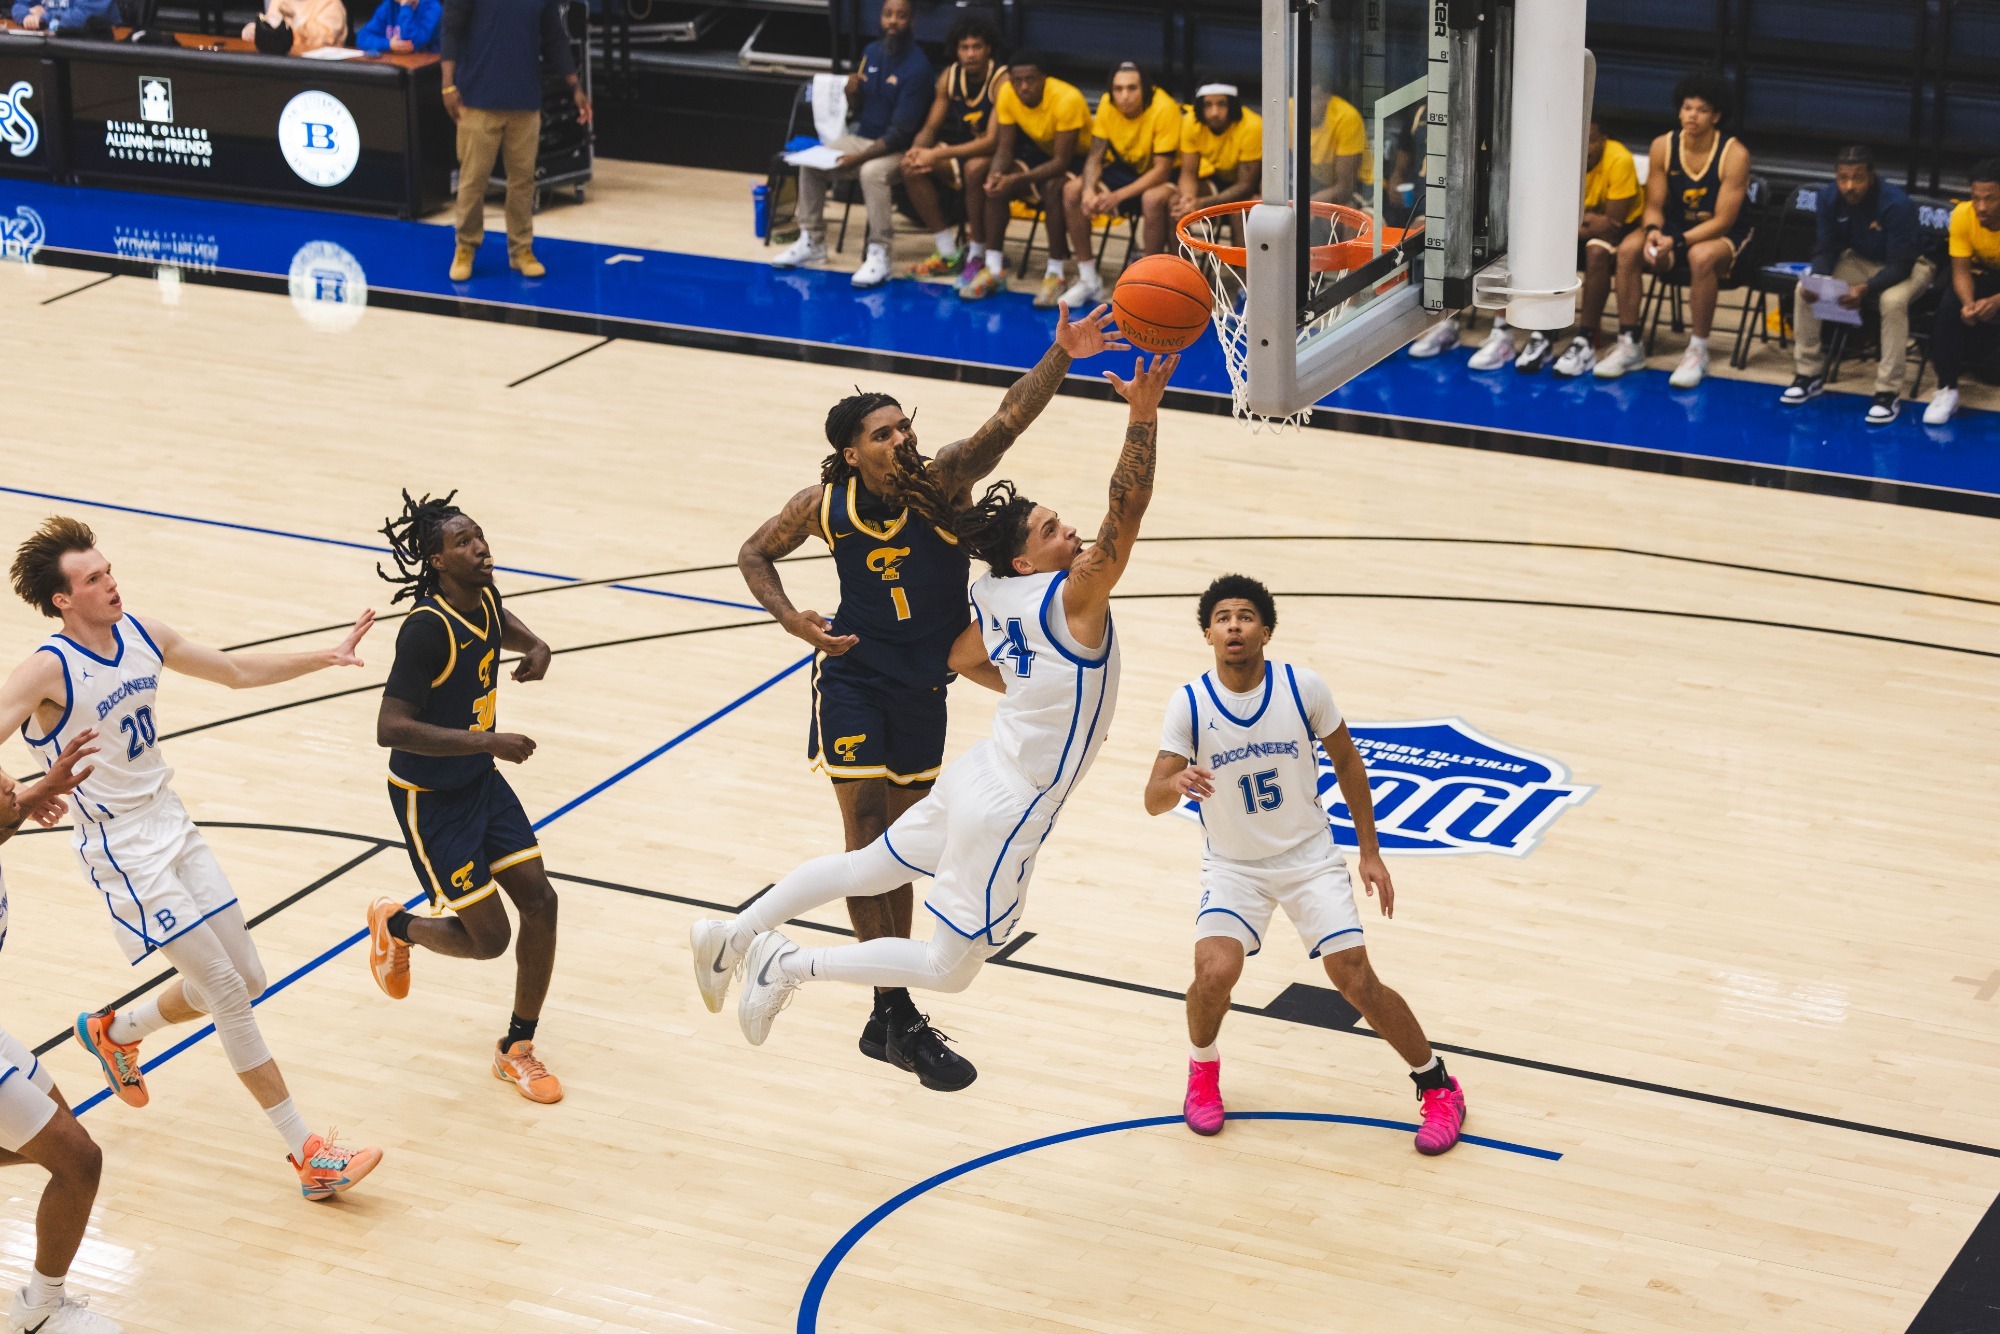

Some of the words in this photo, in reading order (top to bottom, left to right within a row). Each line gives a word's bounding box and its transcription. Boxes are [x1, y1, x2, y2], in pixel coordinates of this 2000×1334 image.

[1429, 113, 1448, 122] 8'6"
[107, 120, 145, 134] BLINN
[151, 124, 208, 140] COLLEGE
[301, 121, 336, 150] B
[106, 132, 153, 150] ALUMNI
[165, 138, 212, 156] FRIENDS
[109, 147, 211, 167] ASSOCIATION
[1438, 176, 1447, 185] 9'
[1122, 319, 1186, 347] SPALDING
[890, 587, 911, 621] 1
[120, 705, 156, 762] 20
[1210, 740, 1299, 770] BUCCANEERS
[1351, 737, 1425, 756] ASSOCI
[1375, 750, 1449, 769] JUNIOR
[1429, 750, 1527, 773] ATHLETIC
[1238, 768, 1284, 814] 15
[154, 908, 177, 933] B
